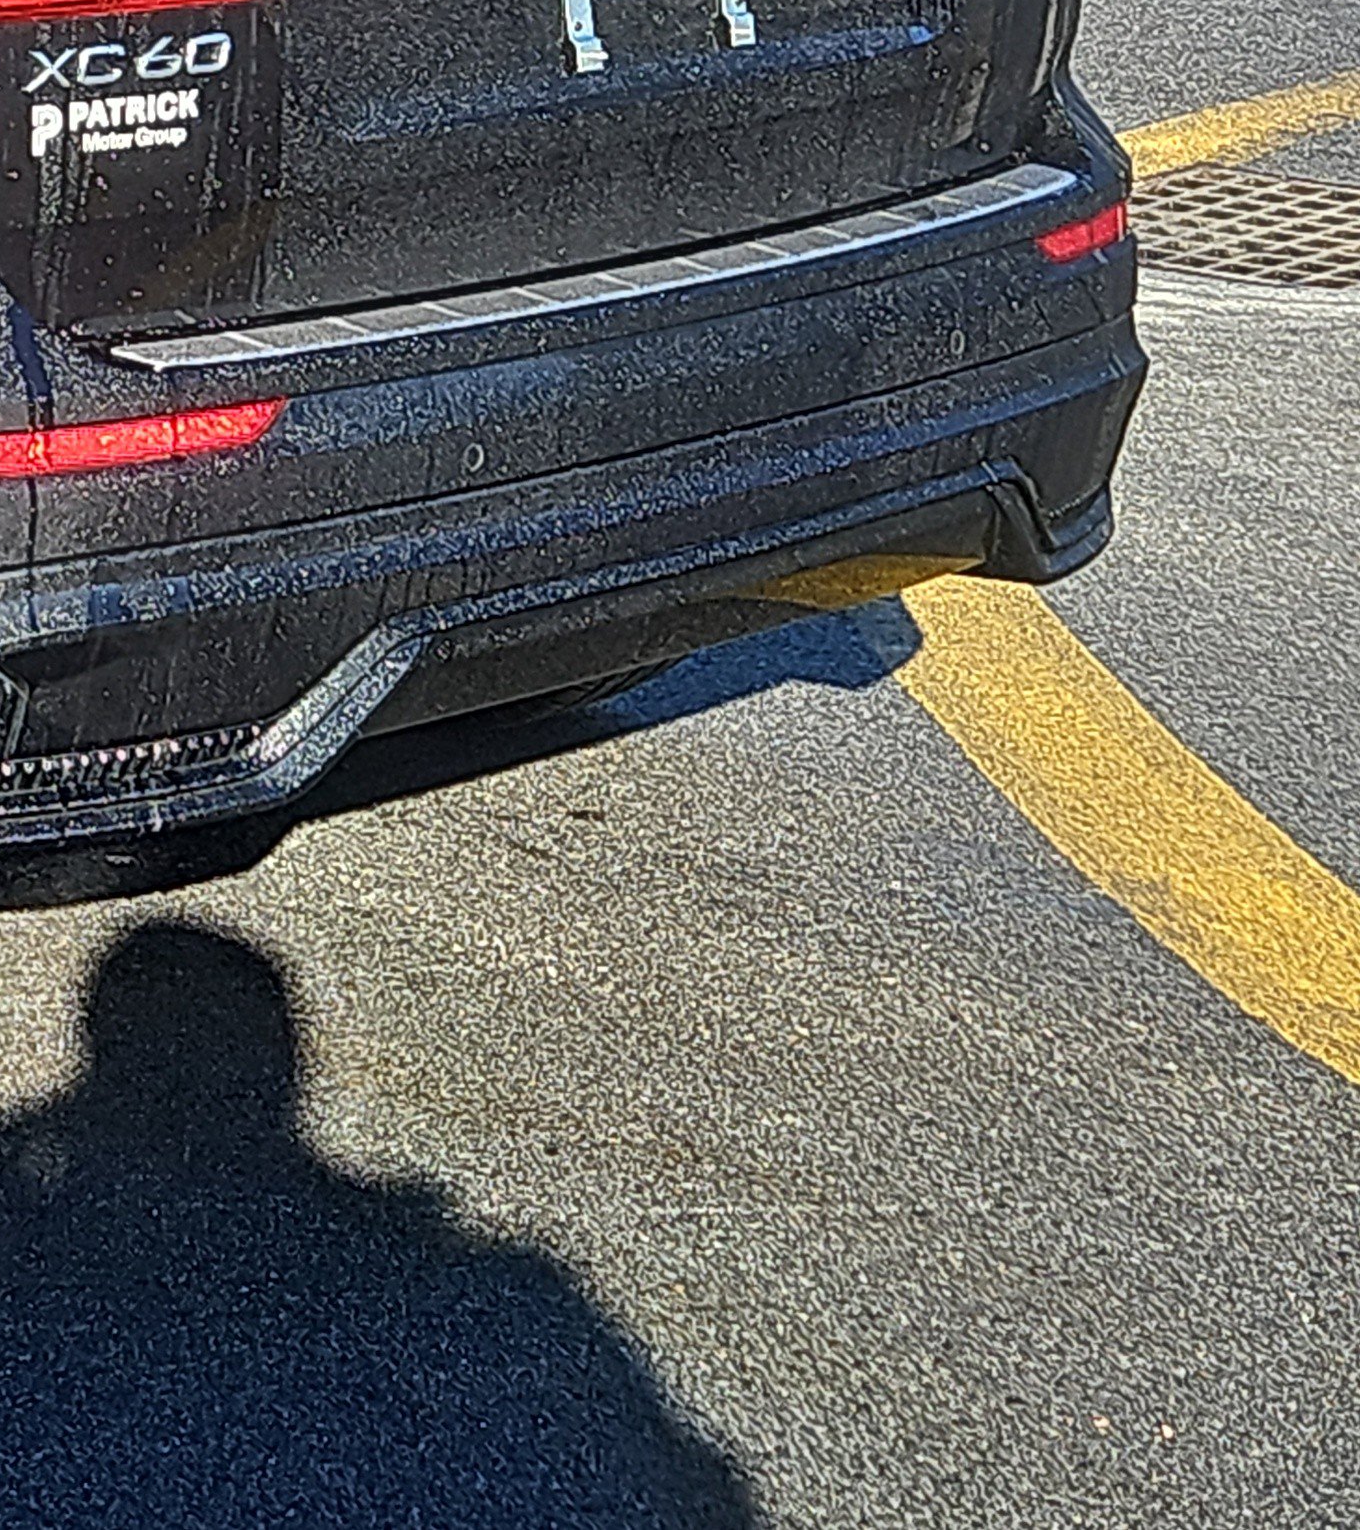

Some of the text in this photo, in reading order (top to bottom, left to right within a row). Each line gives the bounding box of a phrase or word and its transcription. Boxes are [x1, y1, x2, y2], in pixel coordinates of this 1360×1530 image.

[68, 88, 200, 132] PATRICK
[81, 125, 187, 153] Motor Group
